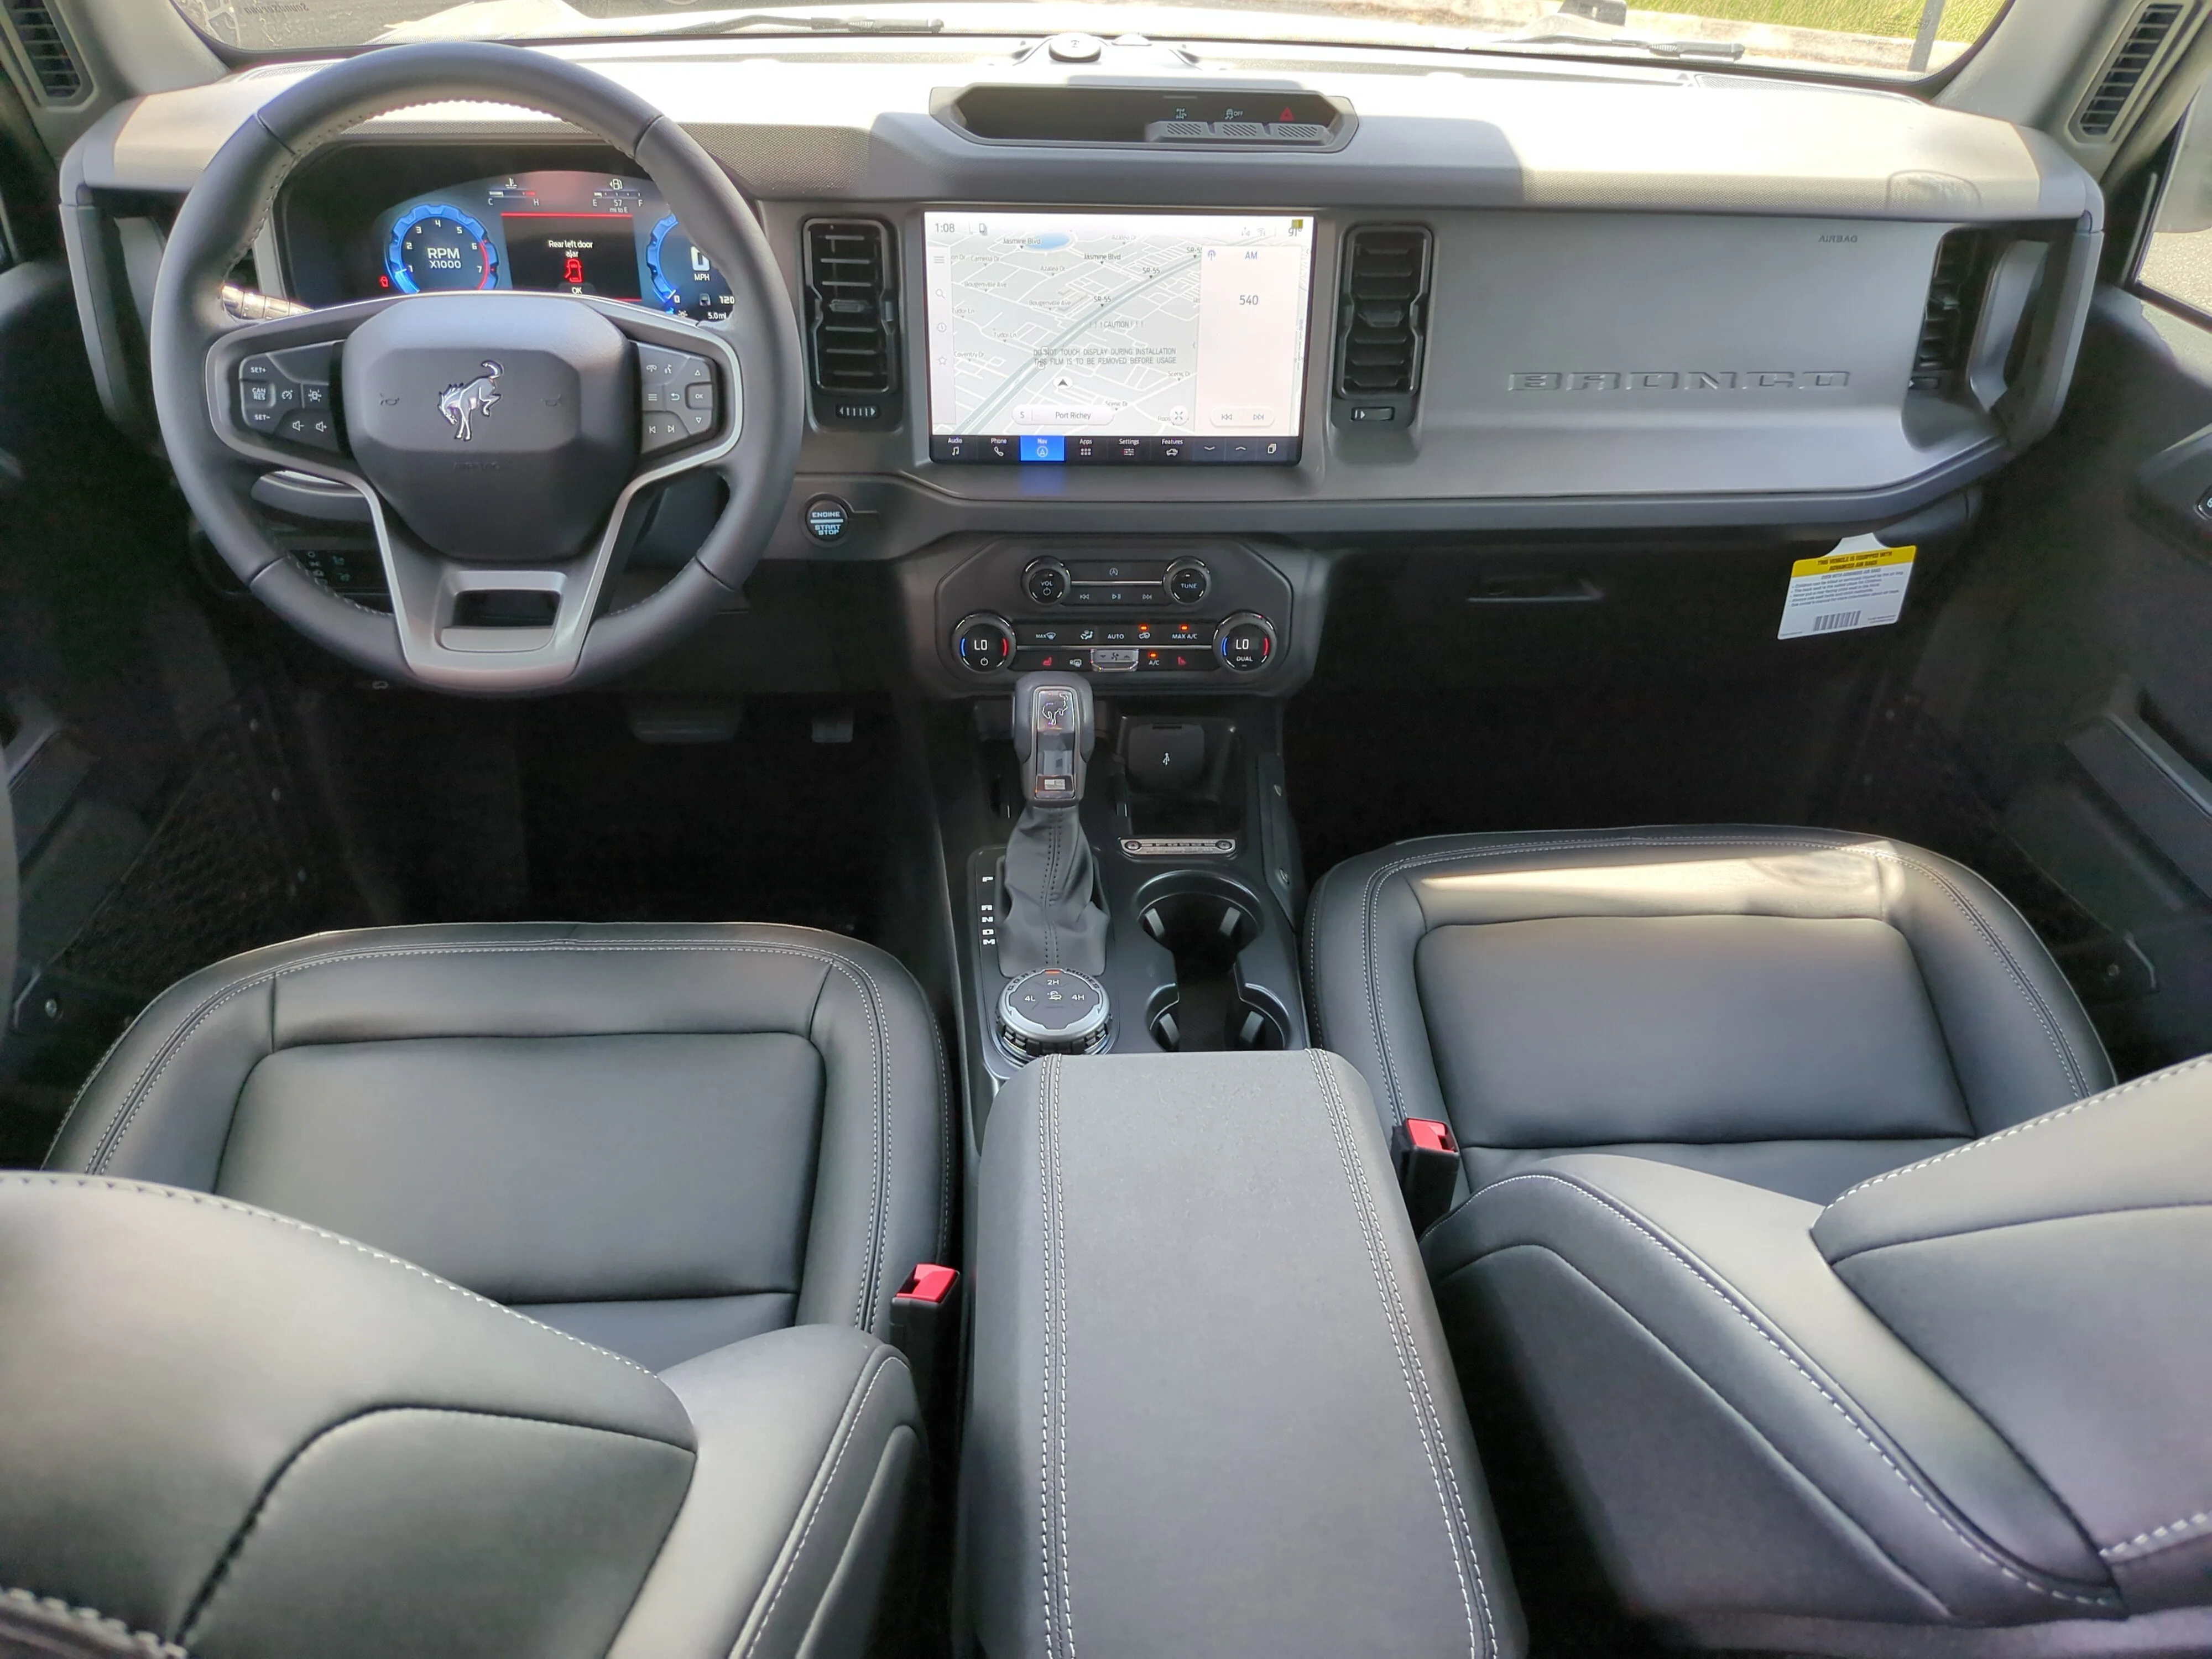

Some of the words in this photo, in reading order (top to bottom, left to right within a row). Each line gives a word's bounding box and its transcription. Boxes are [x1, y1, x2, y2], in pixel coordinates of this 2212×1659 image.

[935, 223, 955, 233] 1:08
[406, 242, 413, 250] 2
[549, 240, 564, 248] Rear
[565, 240, 577, 248] left
[577, 240, 593, 248] door
[427, 247, 460, 259] RPM
[1245, 251, 1258, 259] AM
[430, 260, 461, 269] X1000
[674, 295, 680, 304] 0
[718, 295, 735, 304] 120
[1239, 295, 1259, 305] 540
[1508, 372, 1850, 391] BRONCO
[1070, 411, 1091, 420] Richey
[974, 639, 988, 650] LO
[1235, 639, 1249, 650] LO
[1066, 968, 1100, 989] MODES
